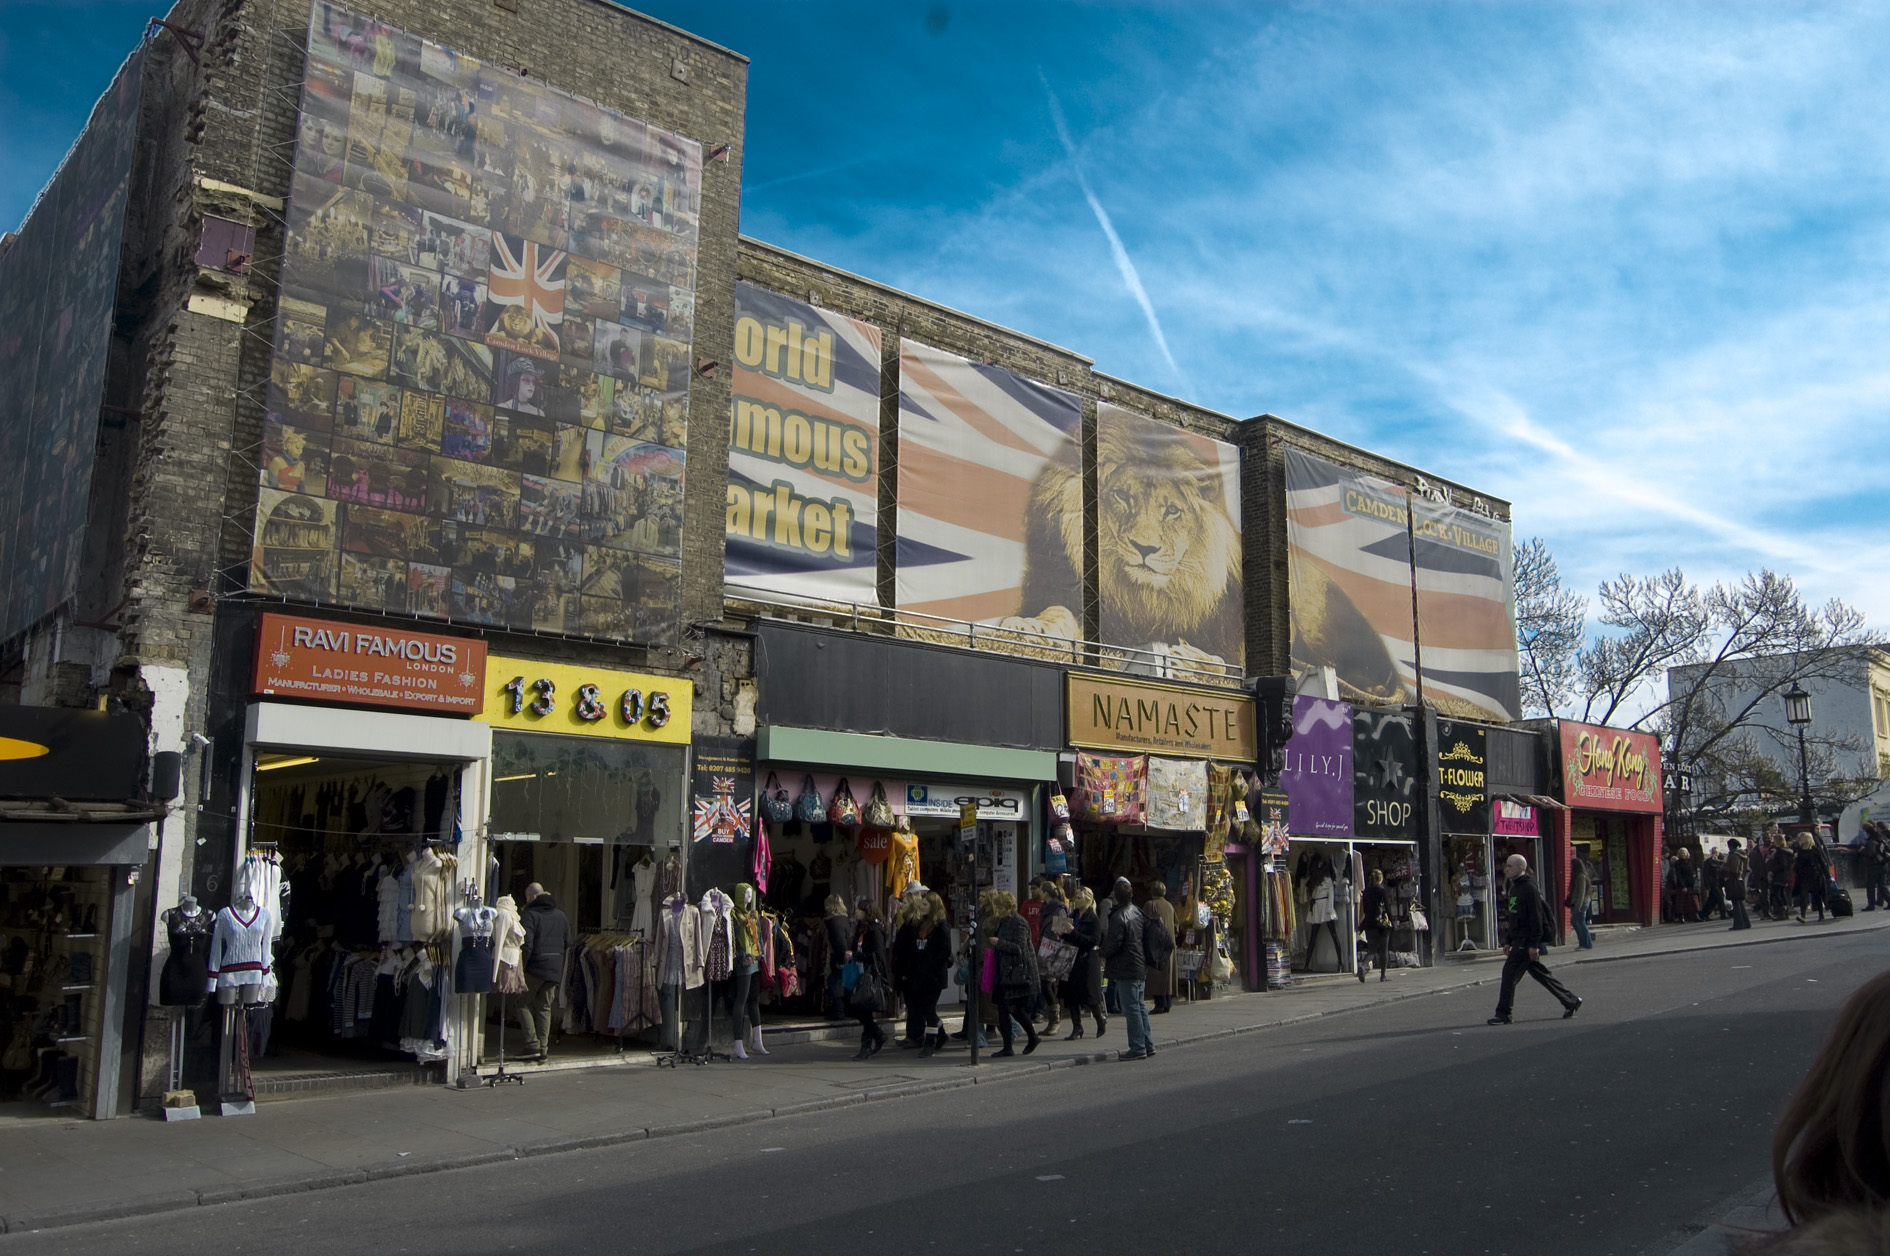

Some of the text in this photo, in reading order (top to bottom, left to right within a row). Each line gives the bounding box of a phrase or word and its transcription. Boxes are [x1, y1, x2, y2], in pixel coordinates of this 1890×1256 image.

[486, 336, 558, 360] Camden Lock Village
[730, 398, 869, 479] mous
[1346, 490, 1499, 555] CAMDEN LOCK VILLAGE
[293, 626, 457, 665] RAVI FAMOUS
[312, 665, 437, 689] LADIES FASHION
[406, 662, 454, 674] LONDON
[268, 677, 341, 692] MANUFACTURER
[347, 685, 399, 698] WHOLESALE
[404, 691, 437, 702] EXPORT
[445, 694, 476, 706] IMPORT
[505, 676, 671, 727] 13 & 05
[1093, 692, 1237, 741] NAMASTE
[1578, 730, 1646, 790] Hong Kong
[928, 796, 1018, 812] INSIDE epiq
[1578, 784, 1650, 802] CHINESE FOOD
[1367, 800, 1412, 826] SHOP
[864, 833, 888, 849] sale
[206, 874, 218, 892] 6
